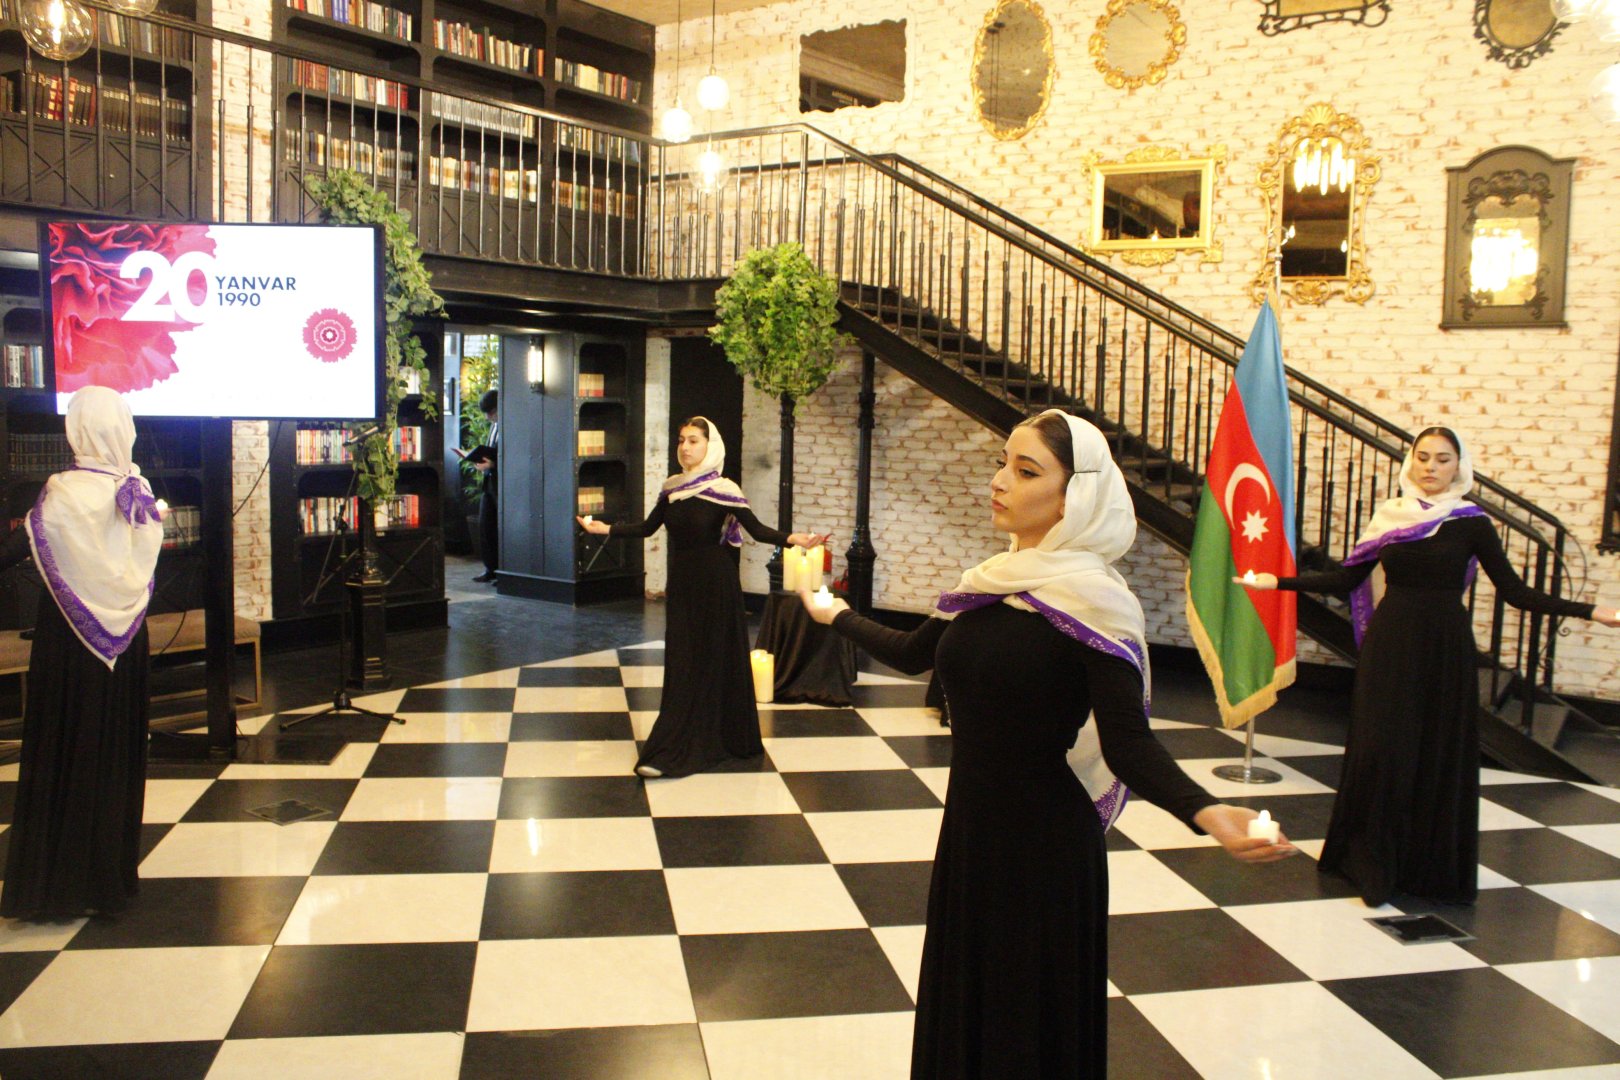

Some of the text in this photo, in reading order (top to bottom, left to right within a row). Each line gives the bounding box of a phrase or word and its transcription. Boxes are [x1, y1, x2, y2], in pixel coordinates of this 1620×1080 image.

[120, 250, 218, 323] 20
[215, 276, 297, 291] YANVAR
[217, 292, 261, 307] 1990
